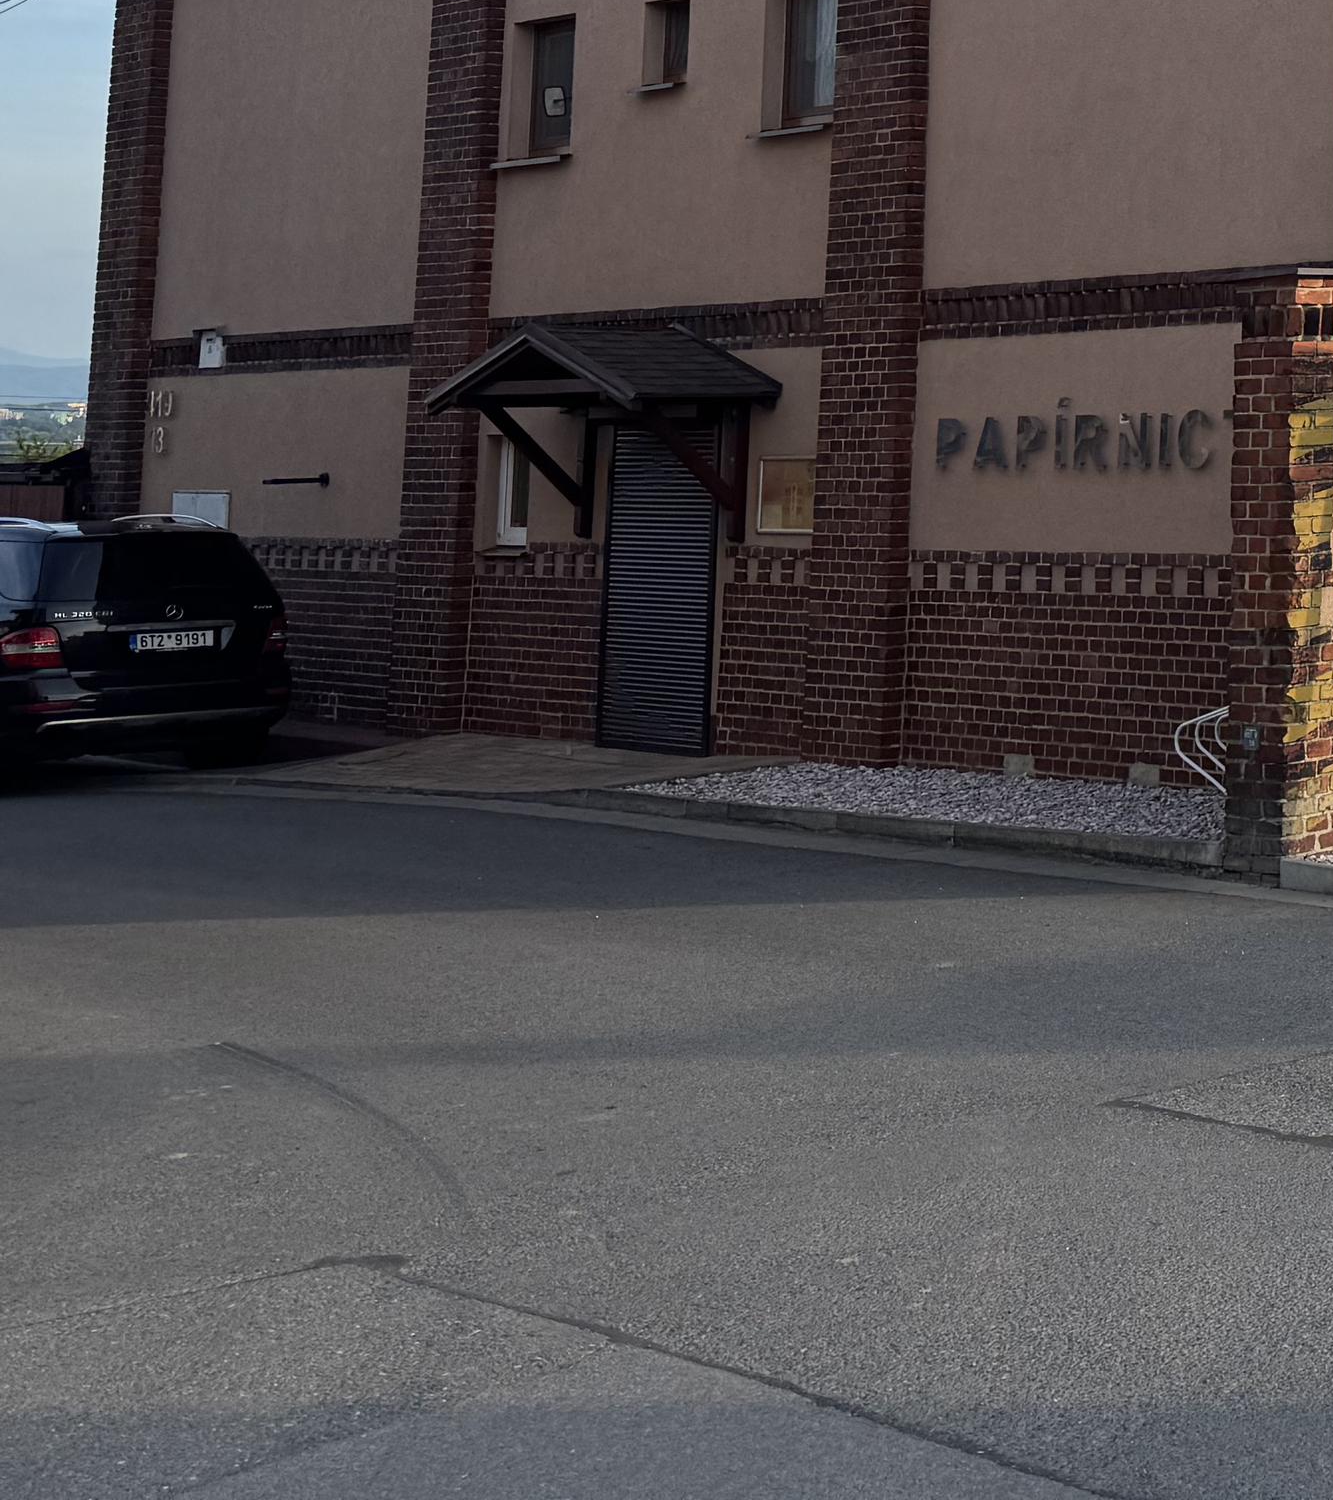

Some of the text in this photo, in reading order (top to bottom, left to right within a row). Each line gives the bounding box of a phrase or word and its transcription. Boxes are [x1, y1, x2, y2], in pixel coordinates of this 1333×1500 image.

[935, 397, 1233, 470] PAPÍRNIC
[140, 632, 206, 648] 6T2 9191
